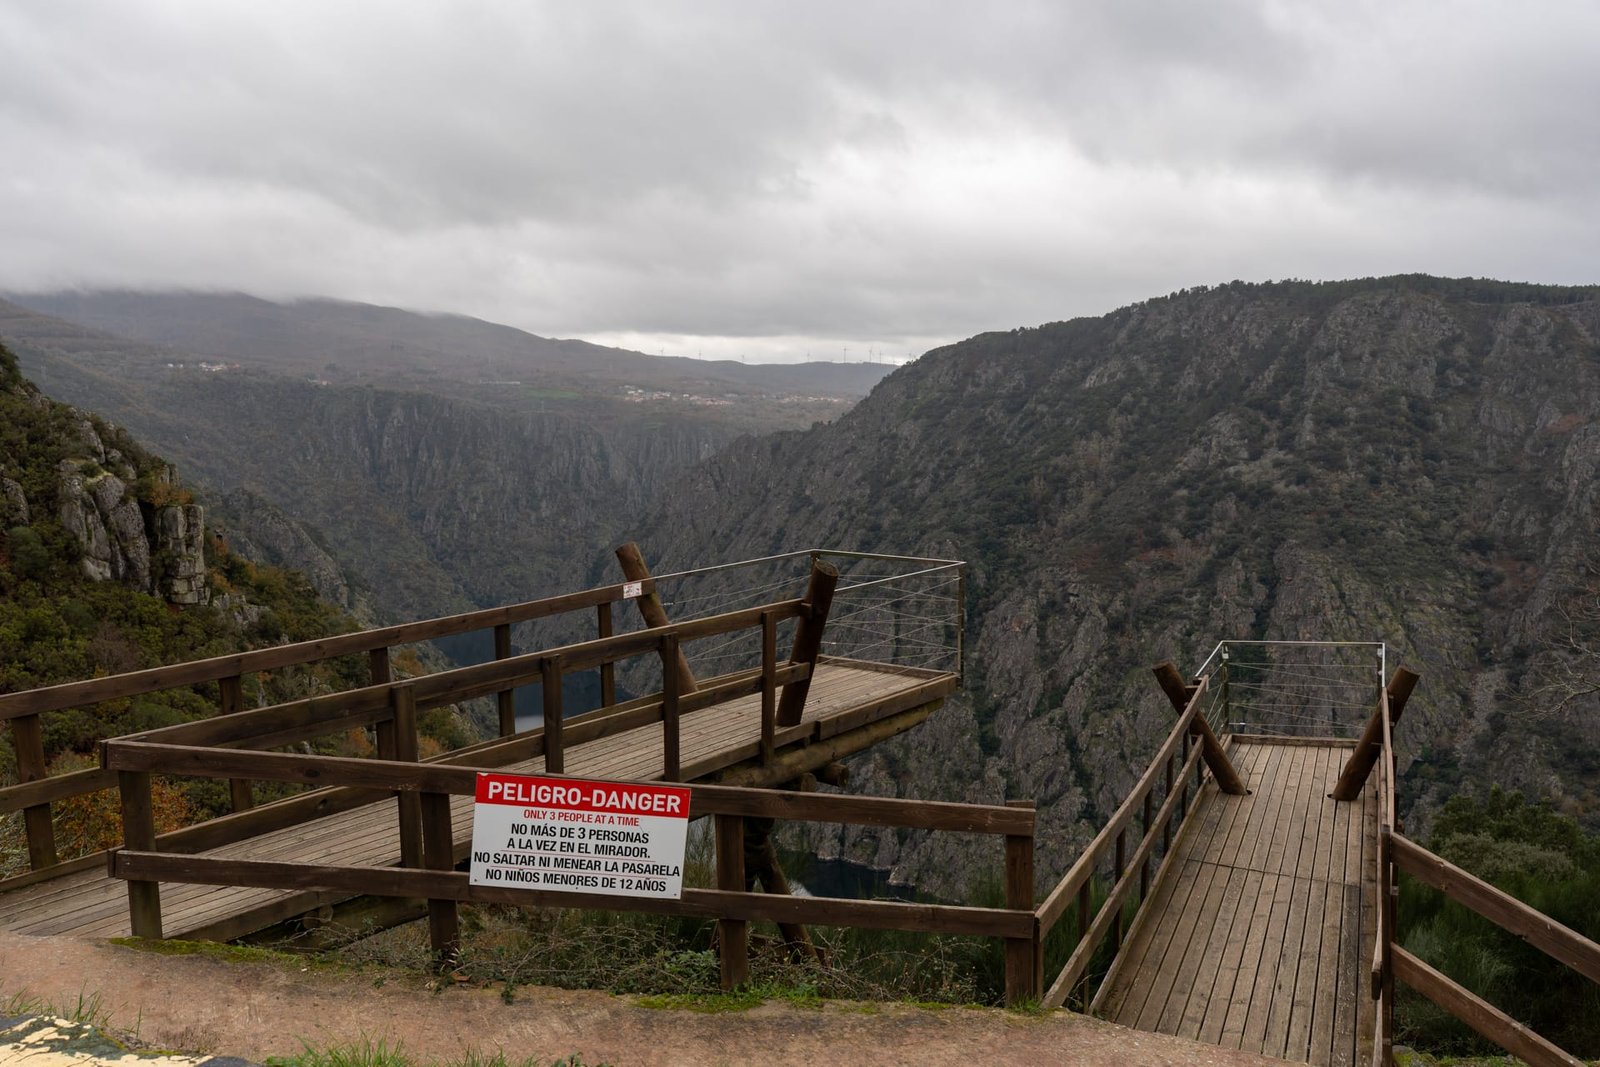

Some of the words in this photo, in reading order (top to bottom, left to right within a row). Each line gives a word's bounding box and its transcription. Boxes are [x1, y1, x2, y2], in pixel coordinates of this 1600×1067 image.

[488, 782, 680, 813] PELIGRO-DANGER
[524, 809, 547, 820] ONLY
[550, 812, 555, 820] 3
[558, 812, 592, 823] PEOPLE
[595, 814, 606, 824] AT
[608, 816, 614, 824] A
[617, 816, 639, 826] TIME
[511, 824, 527, 835] NO
[531, 823, 557, 837] MÁS
[560, 827, 574, 838] DE
[578, 828, 585, 839] 3
[589, 829, 649, 843] PERSONAS
[507, 838, 515, 848] A
[519, 839, 532, 850] LA
[536, 840, 556, 851] VEZ
[560, 842, 574, 852] EN
[578, 843, 591, 854] EL
[595, 844, 650, 858] MIRADOR.
[474, 852, 490, 862] NO
[493, 853, 535, 866] SALTAR
[539, 856, 550, 866] NI
[554, 857, 601, 871] MENEAR
[605, 861, 619, 872] LA
[622, 862, 679, 876] PASARELA
[486, 869, 501, 880] NO
[505, 868, 540, 883] NIÑOS
[543, 873, 598, 887] MENORES
[601, 877, 616, 888] DE
[620, 878, 632, 889] 12
[635, 878, 666, 891] AÑOS
